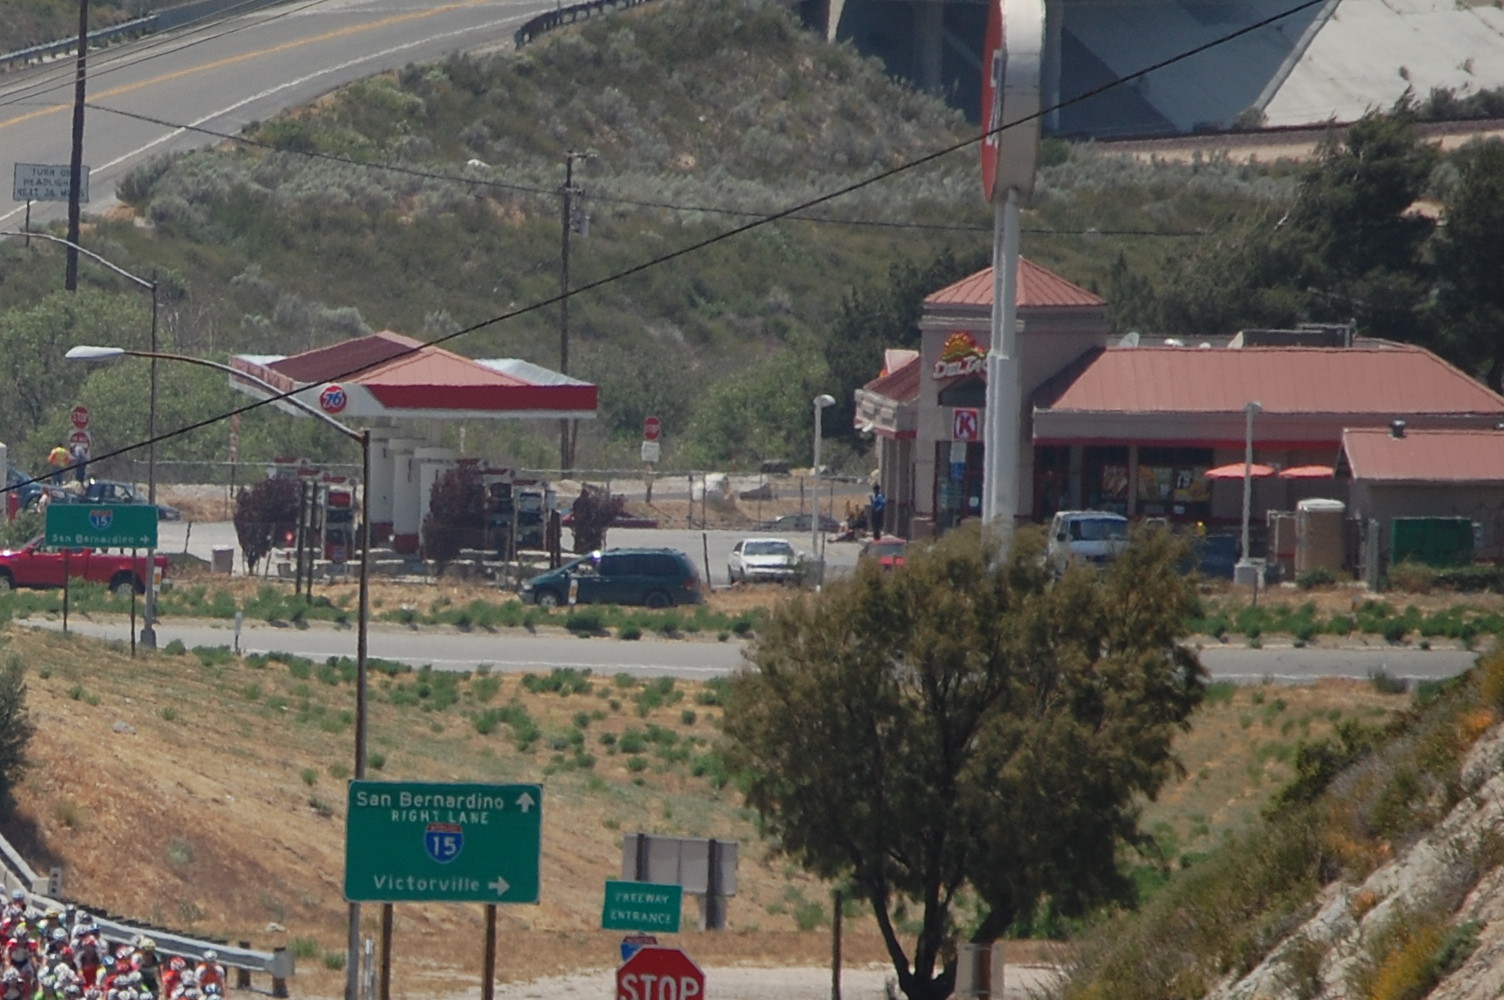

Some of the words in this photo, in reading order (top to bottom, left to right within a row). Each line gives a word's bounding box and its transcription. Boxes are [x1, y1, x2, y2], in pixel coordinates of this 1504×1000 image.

[933, 360, 964, 379] DEL
[323, 390, 343, 408] 76
[95, 517, 108, 527] 15
[51, 533, 71, 543] San
[76, 533, 134, 544] Bernardino
[356, 792, 391, 807] San
[400, 792, 504, 809] Bernardino
[392, 810, 439, 822] RIGHT
[448, 811, 489, 824] LANE
[433, 836, 456, 856] 15
[373, 875, 480, 891] Victorville
[615, 893, 669, 904] FREEWAY
[610, 910, 672, 924] ENTRANCE
